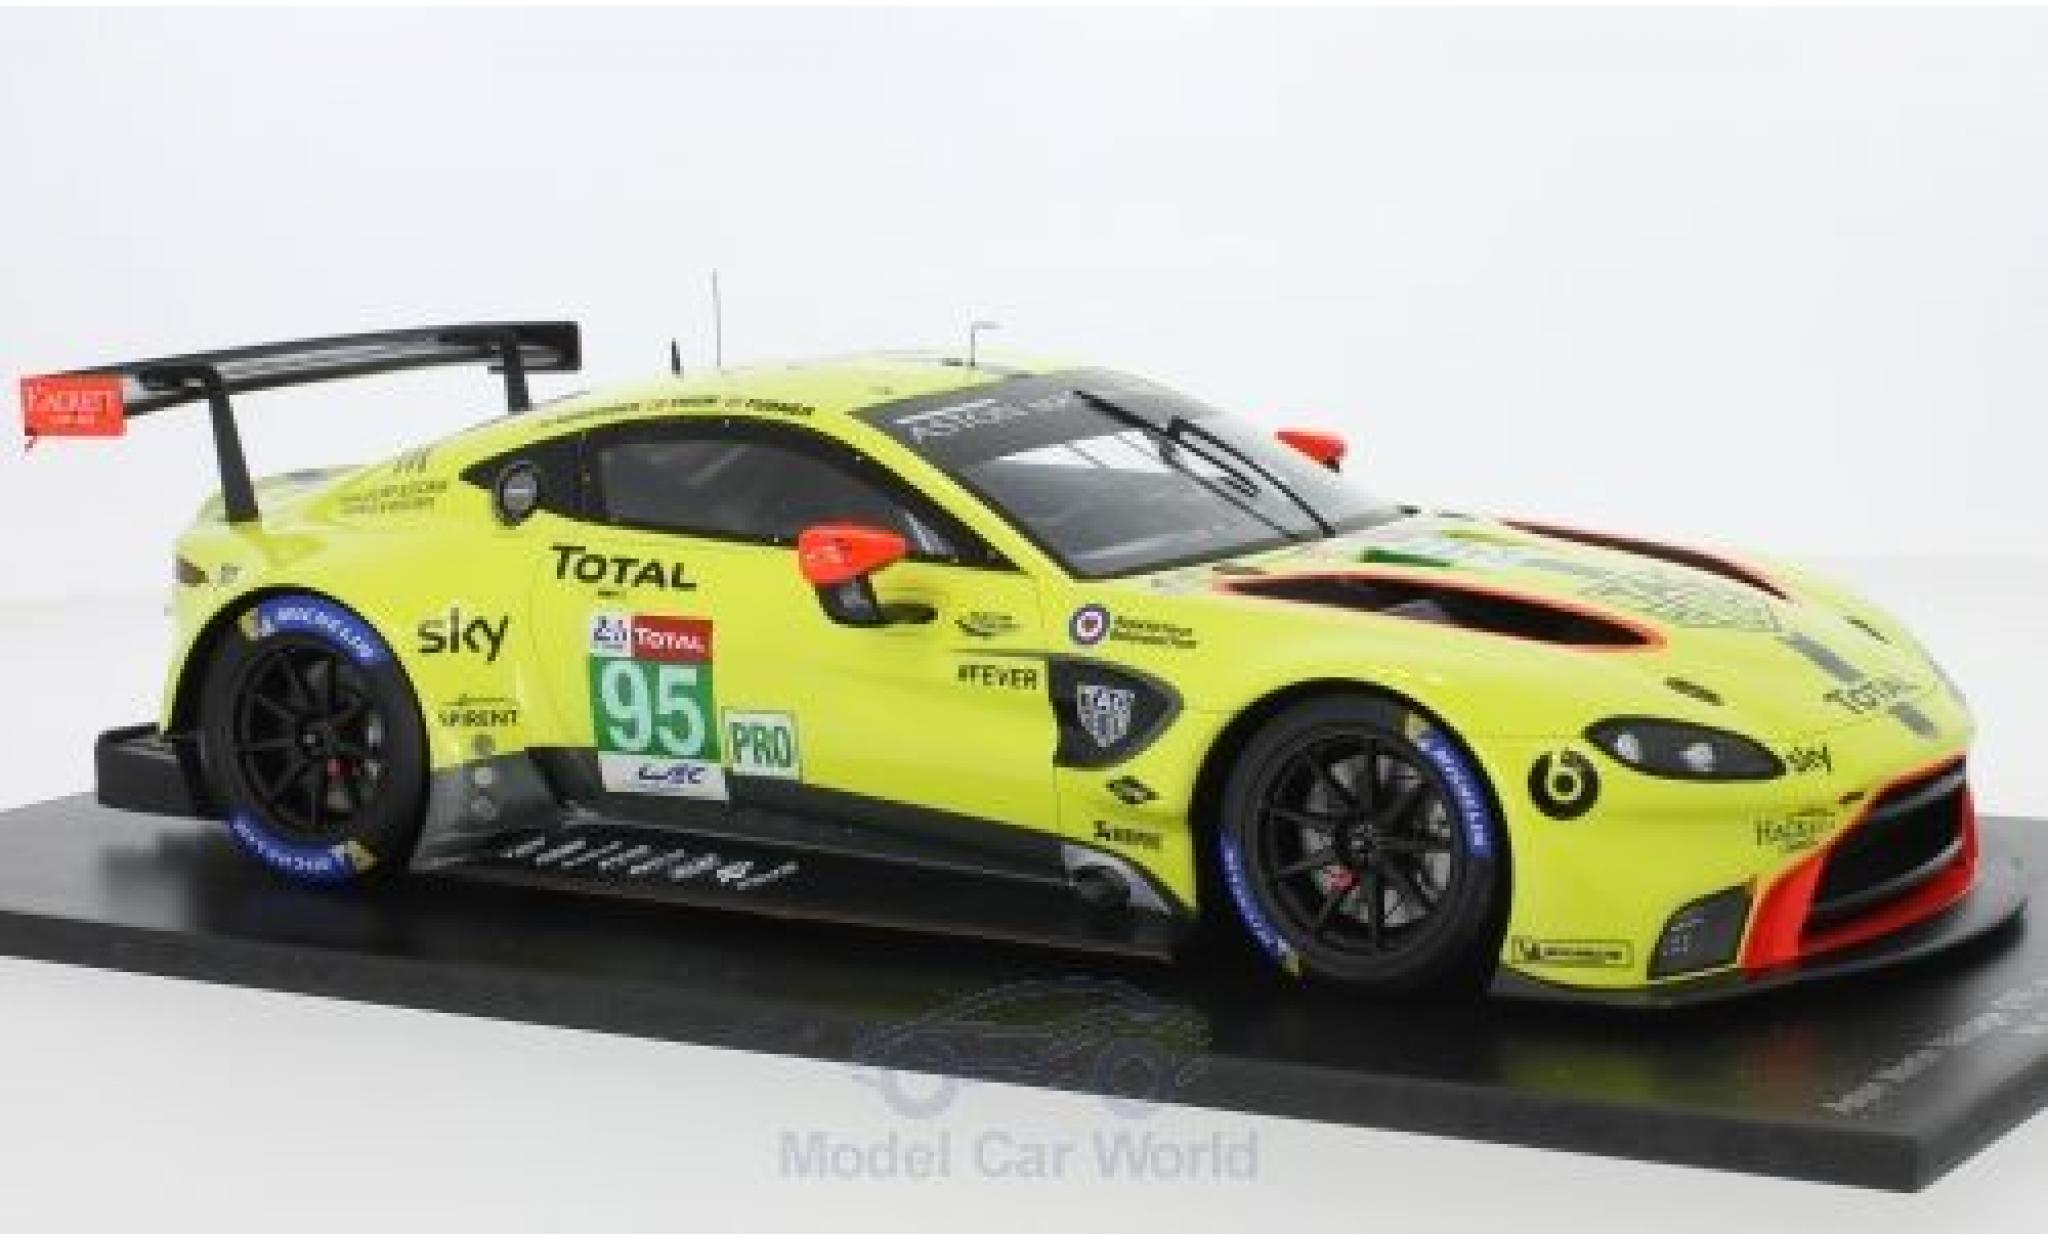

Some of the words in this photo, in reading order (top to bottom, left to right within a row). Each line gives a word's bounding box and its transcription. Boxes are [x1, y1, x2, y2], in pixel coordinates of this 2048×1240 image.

[552, 543, 697, 590] TOTAL
[417, 607, 510, 664] sky
[634, 626, 707, 654] TOTAL
[601, 660, 707, 757] 95
[729, 721, 792, 769] PRO
